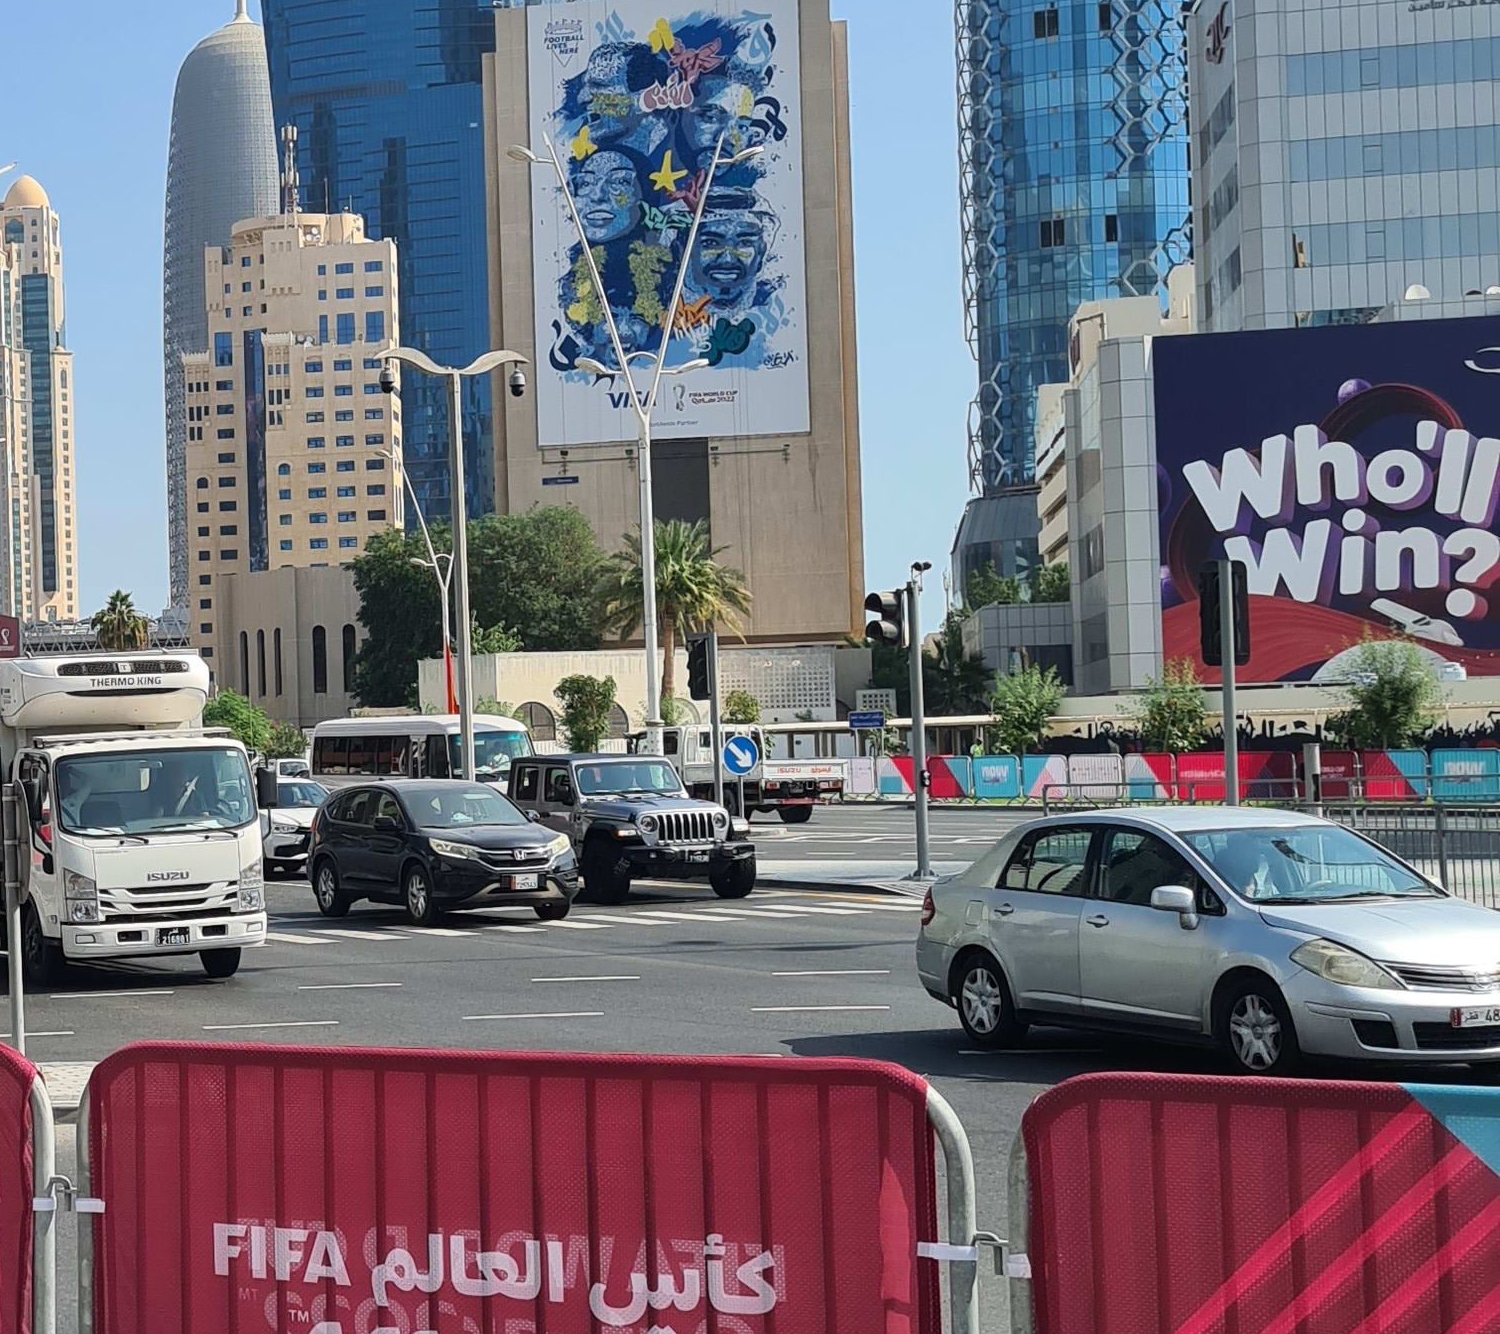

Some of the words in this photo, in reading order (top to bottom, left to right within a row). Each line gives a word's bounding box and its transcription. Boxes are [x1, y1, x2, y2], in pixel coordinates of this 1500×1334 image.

[543, 34, 585, 44] FOOTBALL
[546, 42, 568, 50] LIVES
[558, 47, 579, 55] HERE
[1182, 419, 1500, 533] Who'll
[1223, 517, 1500, 618] Win?
[90, 677, 135, 688] THERMO
[137, 676, 162, 685] KING
[147, 871, 190, 882] ISUZU
[212, 1222, 352, 1287] FIFA
[370, 1232, 565, 1308] العالم
[589, 1232, 778, 1327] كأس
